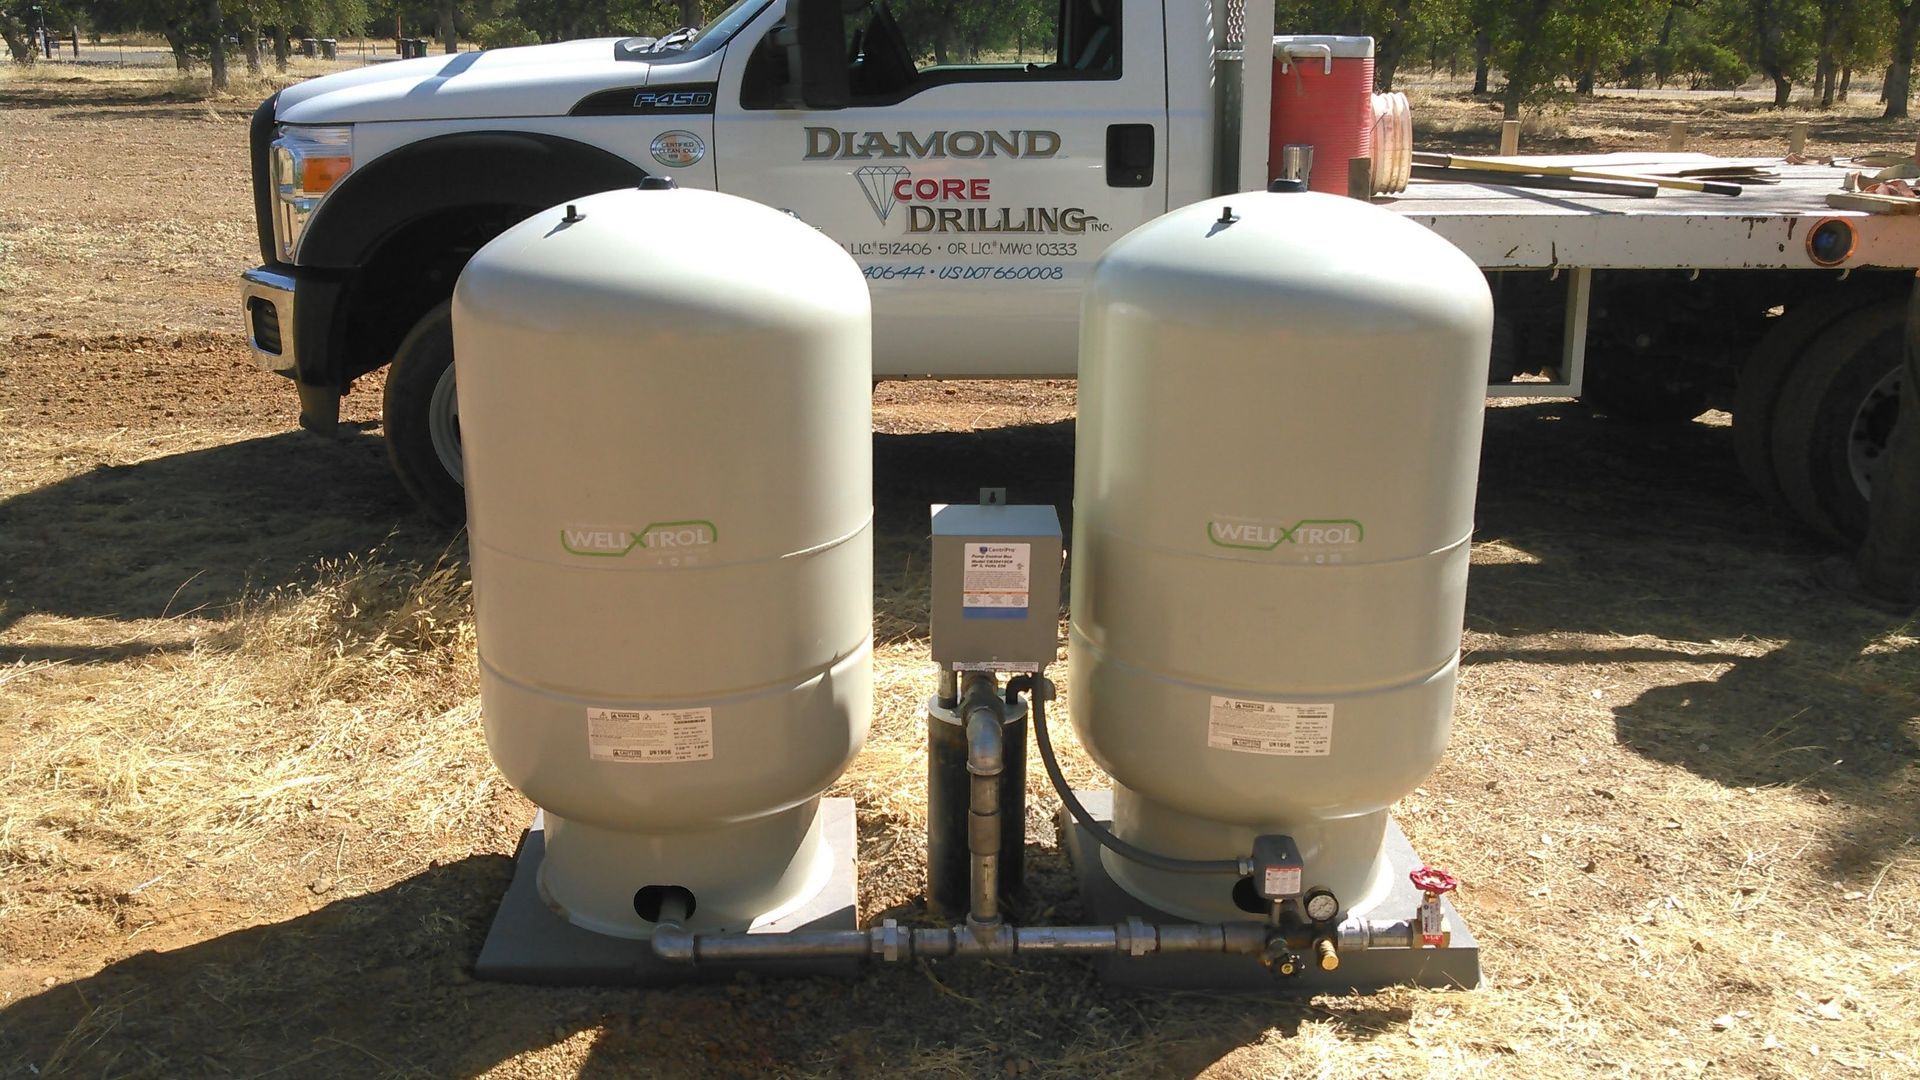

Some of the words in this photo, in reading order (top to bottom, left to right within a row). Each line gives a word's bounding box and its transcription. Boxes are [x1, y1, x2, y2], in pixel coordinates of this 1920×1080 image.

[633, 92, 713, 108] F-450
[802, 126, 1062, 161] DIAMOND
[893, 178, 991, 202] CORE
[904, 204, 1099, 234] DRILLING
[1091, 222, 1113, 233] INC.
[947, 242, 968, 255] OR
[1036, 243, 1078, 256] 10333
